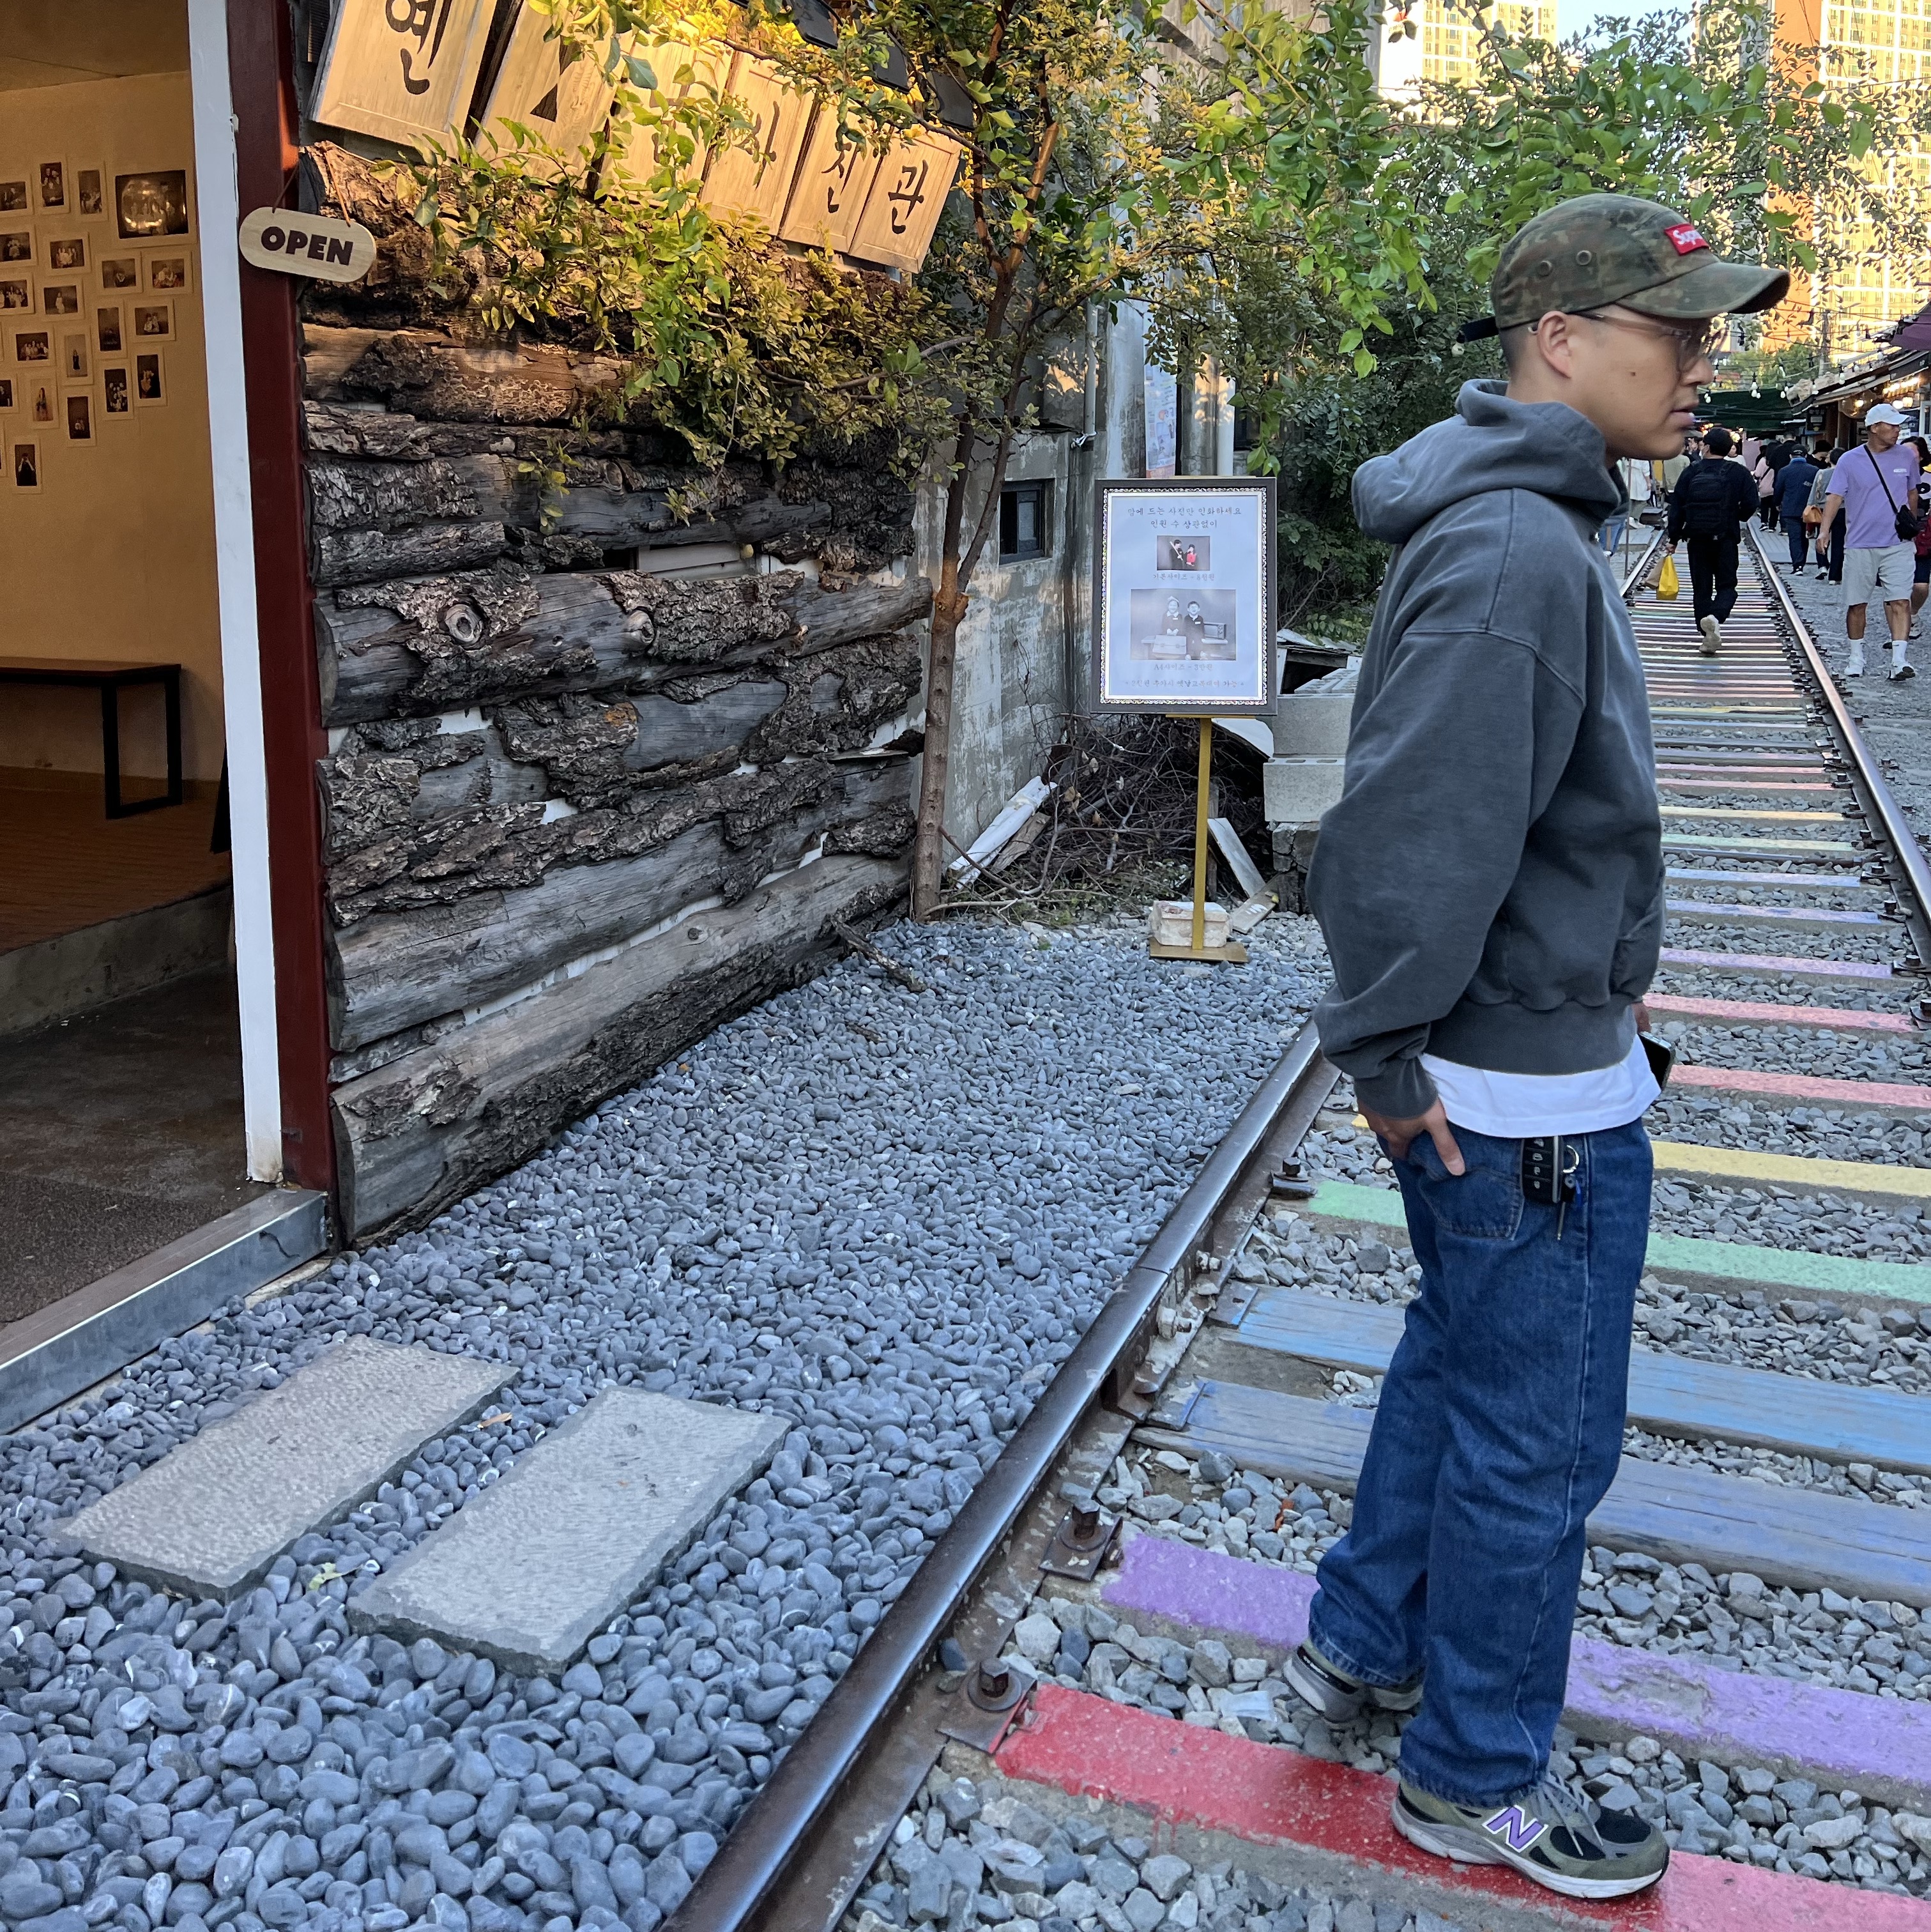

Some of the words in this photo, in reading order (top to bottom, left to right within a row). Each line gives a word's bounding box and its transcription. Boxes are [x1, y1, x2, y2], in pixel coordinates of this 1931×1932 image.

[261, 226, 354, 266] OPEN
[1147, 507, 1165, 516] 드는
[1168, 507, 1194, 516] 사진만
[1198, 507, 1241, 516] 인화하세요
[1150, 519, 1166, 529] 인원
[1171, 520, 1179, 528] 수
[1183, 519, 1217, 529] 상관없이
[1482, 1804, 1548, 1852] N
